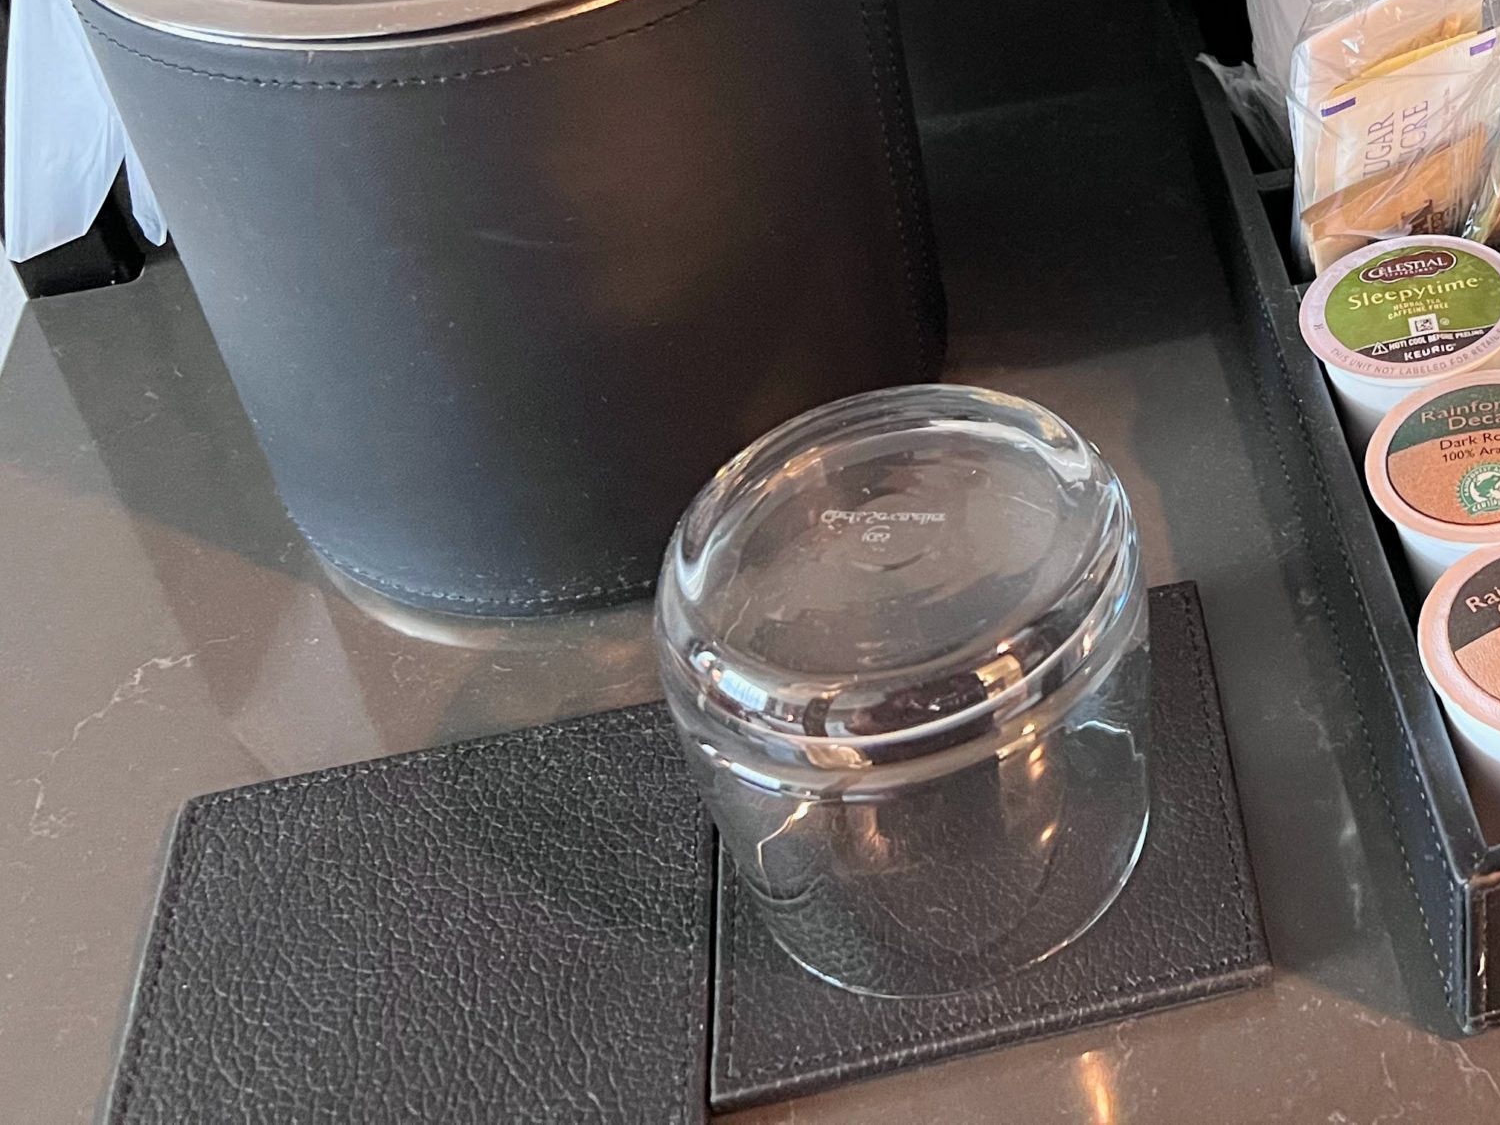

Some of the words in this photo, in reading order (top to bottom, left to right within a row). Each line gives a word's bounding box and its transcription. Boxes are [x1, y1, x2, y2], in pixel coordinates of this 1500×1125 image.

[1363, 112, 1396, 178] UGAR
[1347, 277, 1480, 310] Sleepytime
[1428, 302, 1449, 311] FREE
[1350, 360, 1373, 371] UNIT
[1375, 367, 1395, 375] NOT
[1400, 364, 1447, 375] LABELED
[1450, 354, 1469, 366] FOR
[1471, 335, 1500, 356] RETAIL
[1403, 344, 1455, 361] KEURIG
[1439, 434, 1479, 451] Dark
[1442, 448, 1476, 463] 100%
